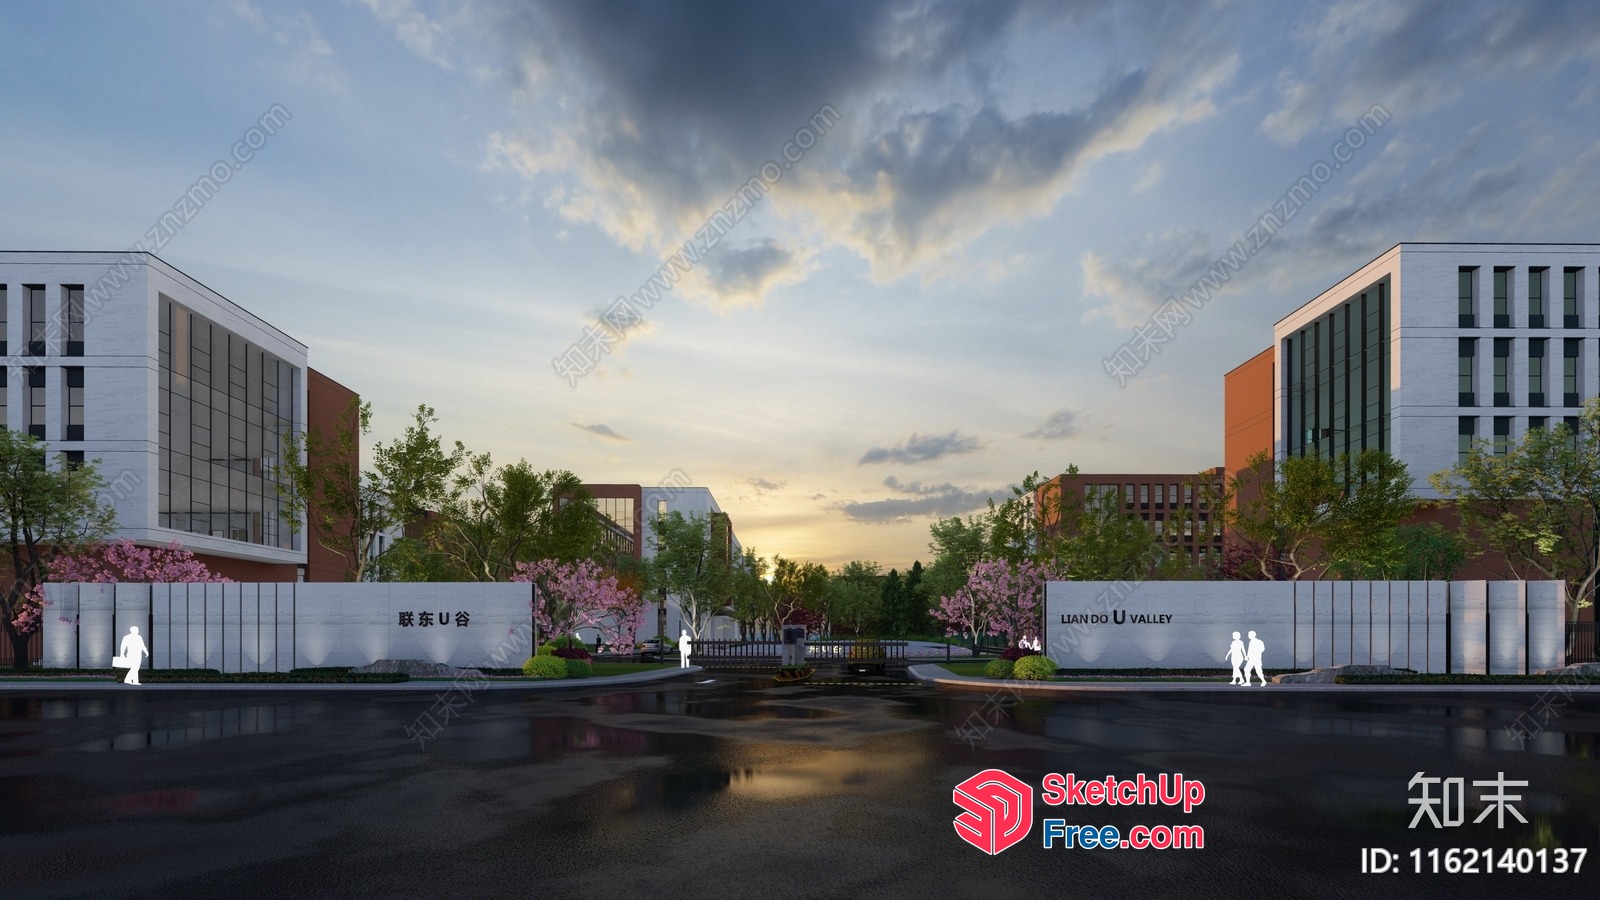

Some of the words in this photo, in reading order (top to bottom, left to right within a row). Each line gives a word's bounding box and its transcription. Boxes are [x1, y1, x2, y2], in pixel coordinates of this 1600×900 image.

[398, 611, 470, 628] 联东U谷
[1113, 609, 1126, 625] U
[1130, 614, 1173, 624] VALLEY
